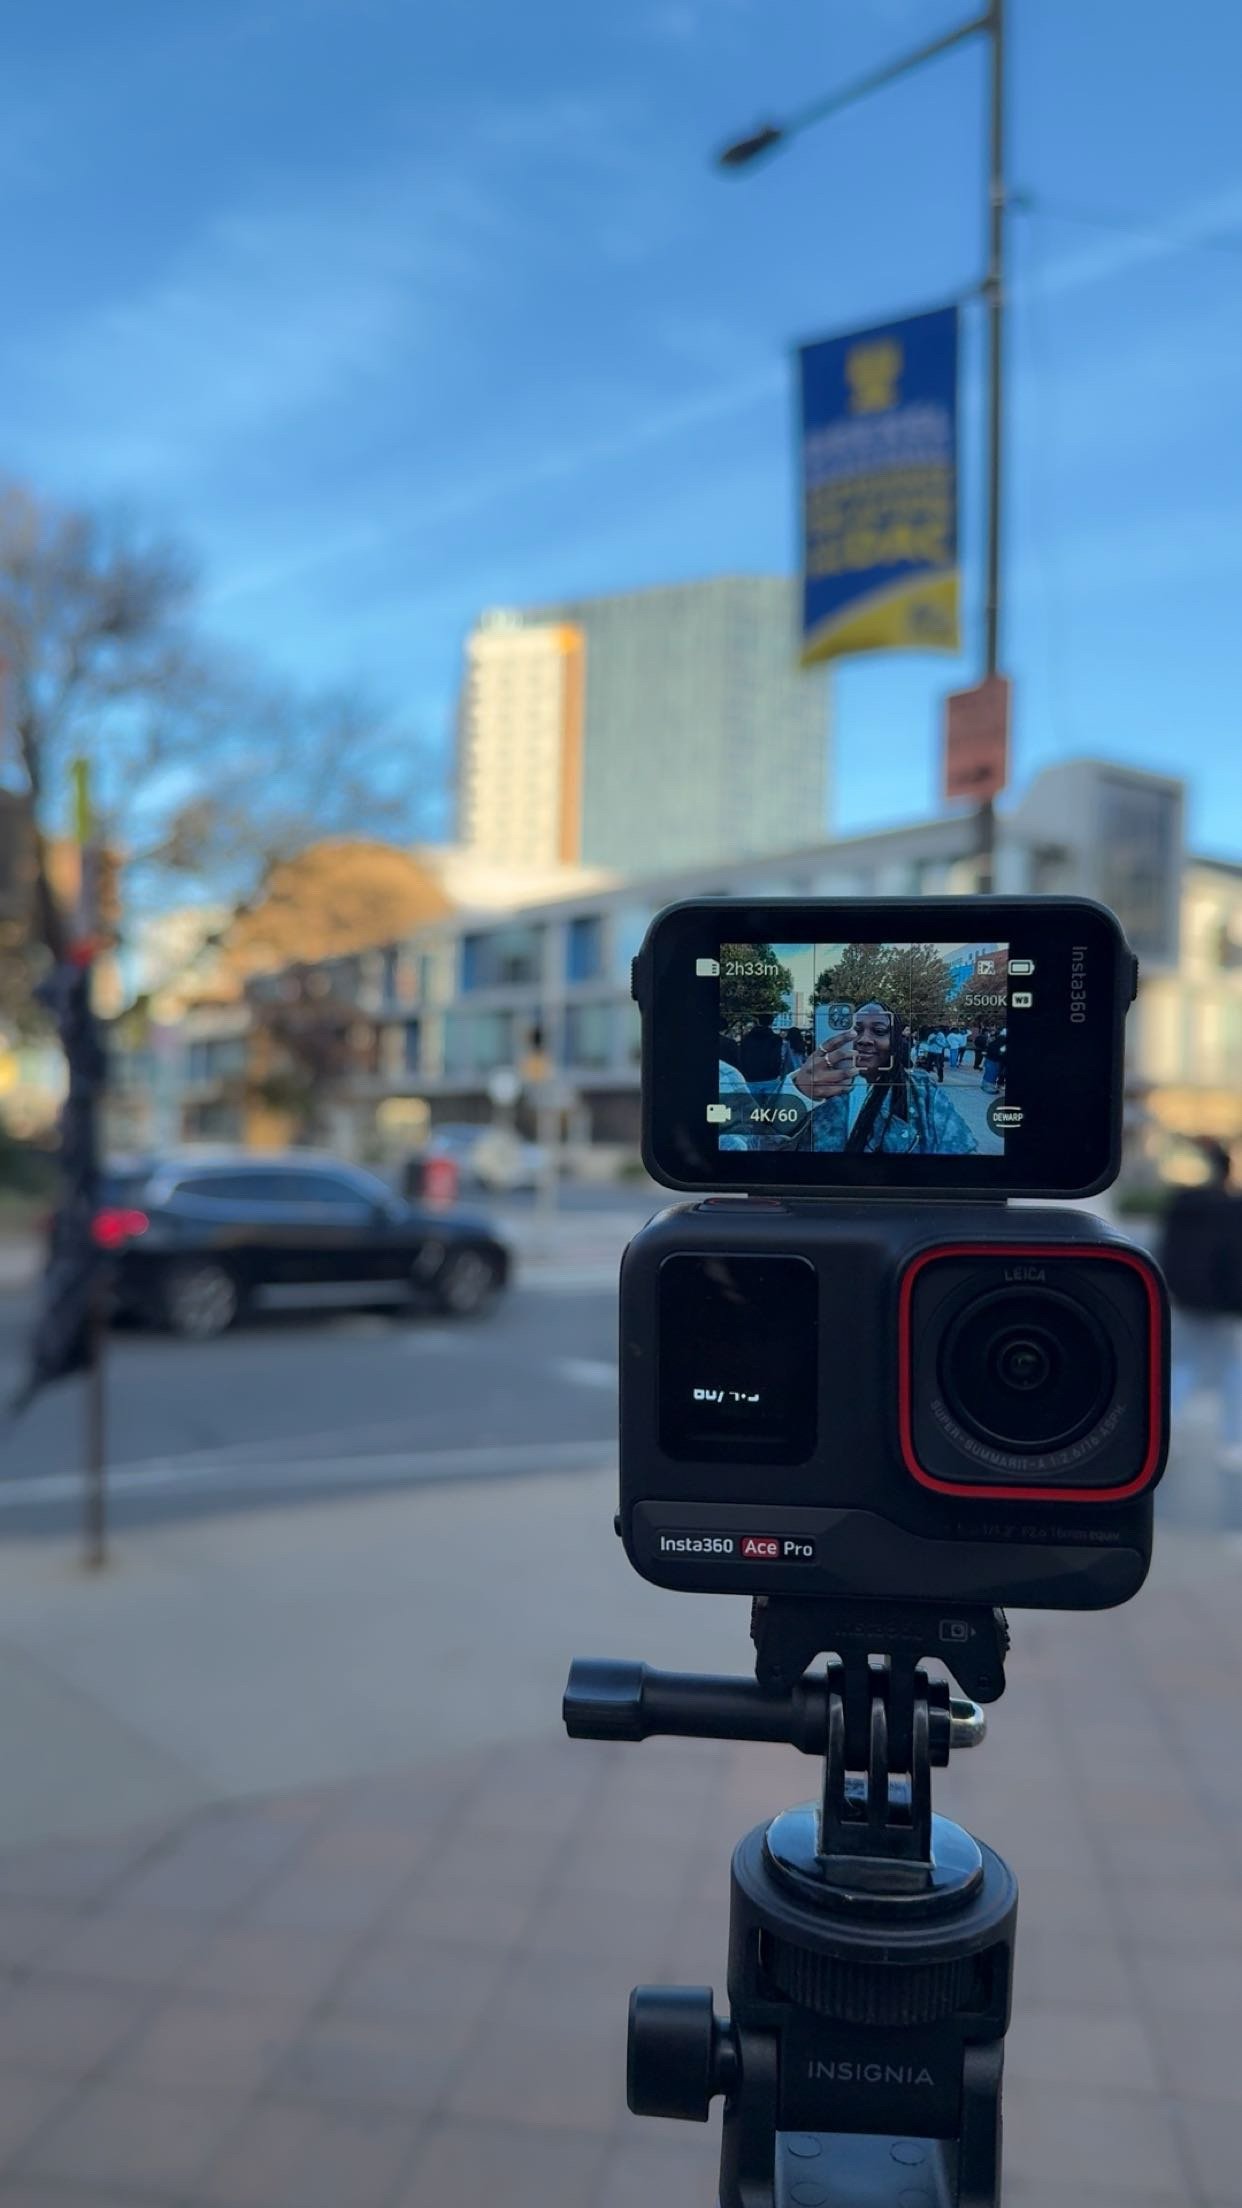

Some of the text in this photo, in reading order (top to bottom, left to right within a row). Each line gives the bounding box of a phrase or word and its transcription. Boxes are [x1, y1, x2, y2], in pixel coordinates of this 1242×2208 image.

[725, 961, 779, 976] 2h33m
[1070, 946, 1087, 1023] Insta360
[964, 994, 1008, 1006] 5500K
[750, 1108, 798, 1122] 4K/60
[992, 1112, 1024, 1122] DEWARP
[1003, 1265, 1046, 1282] LEICA
[660, 1535, 813, 1557] Insta360 Ace Pro
[808, 2060, 935, 2086] INSIGNIA
